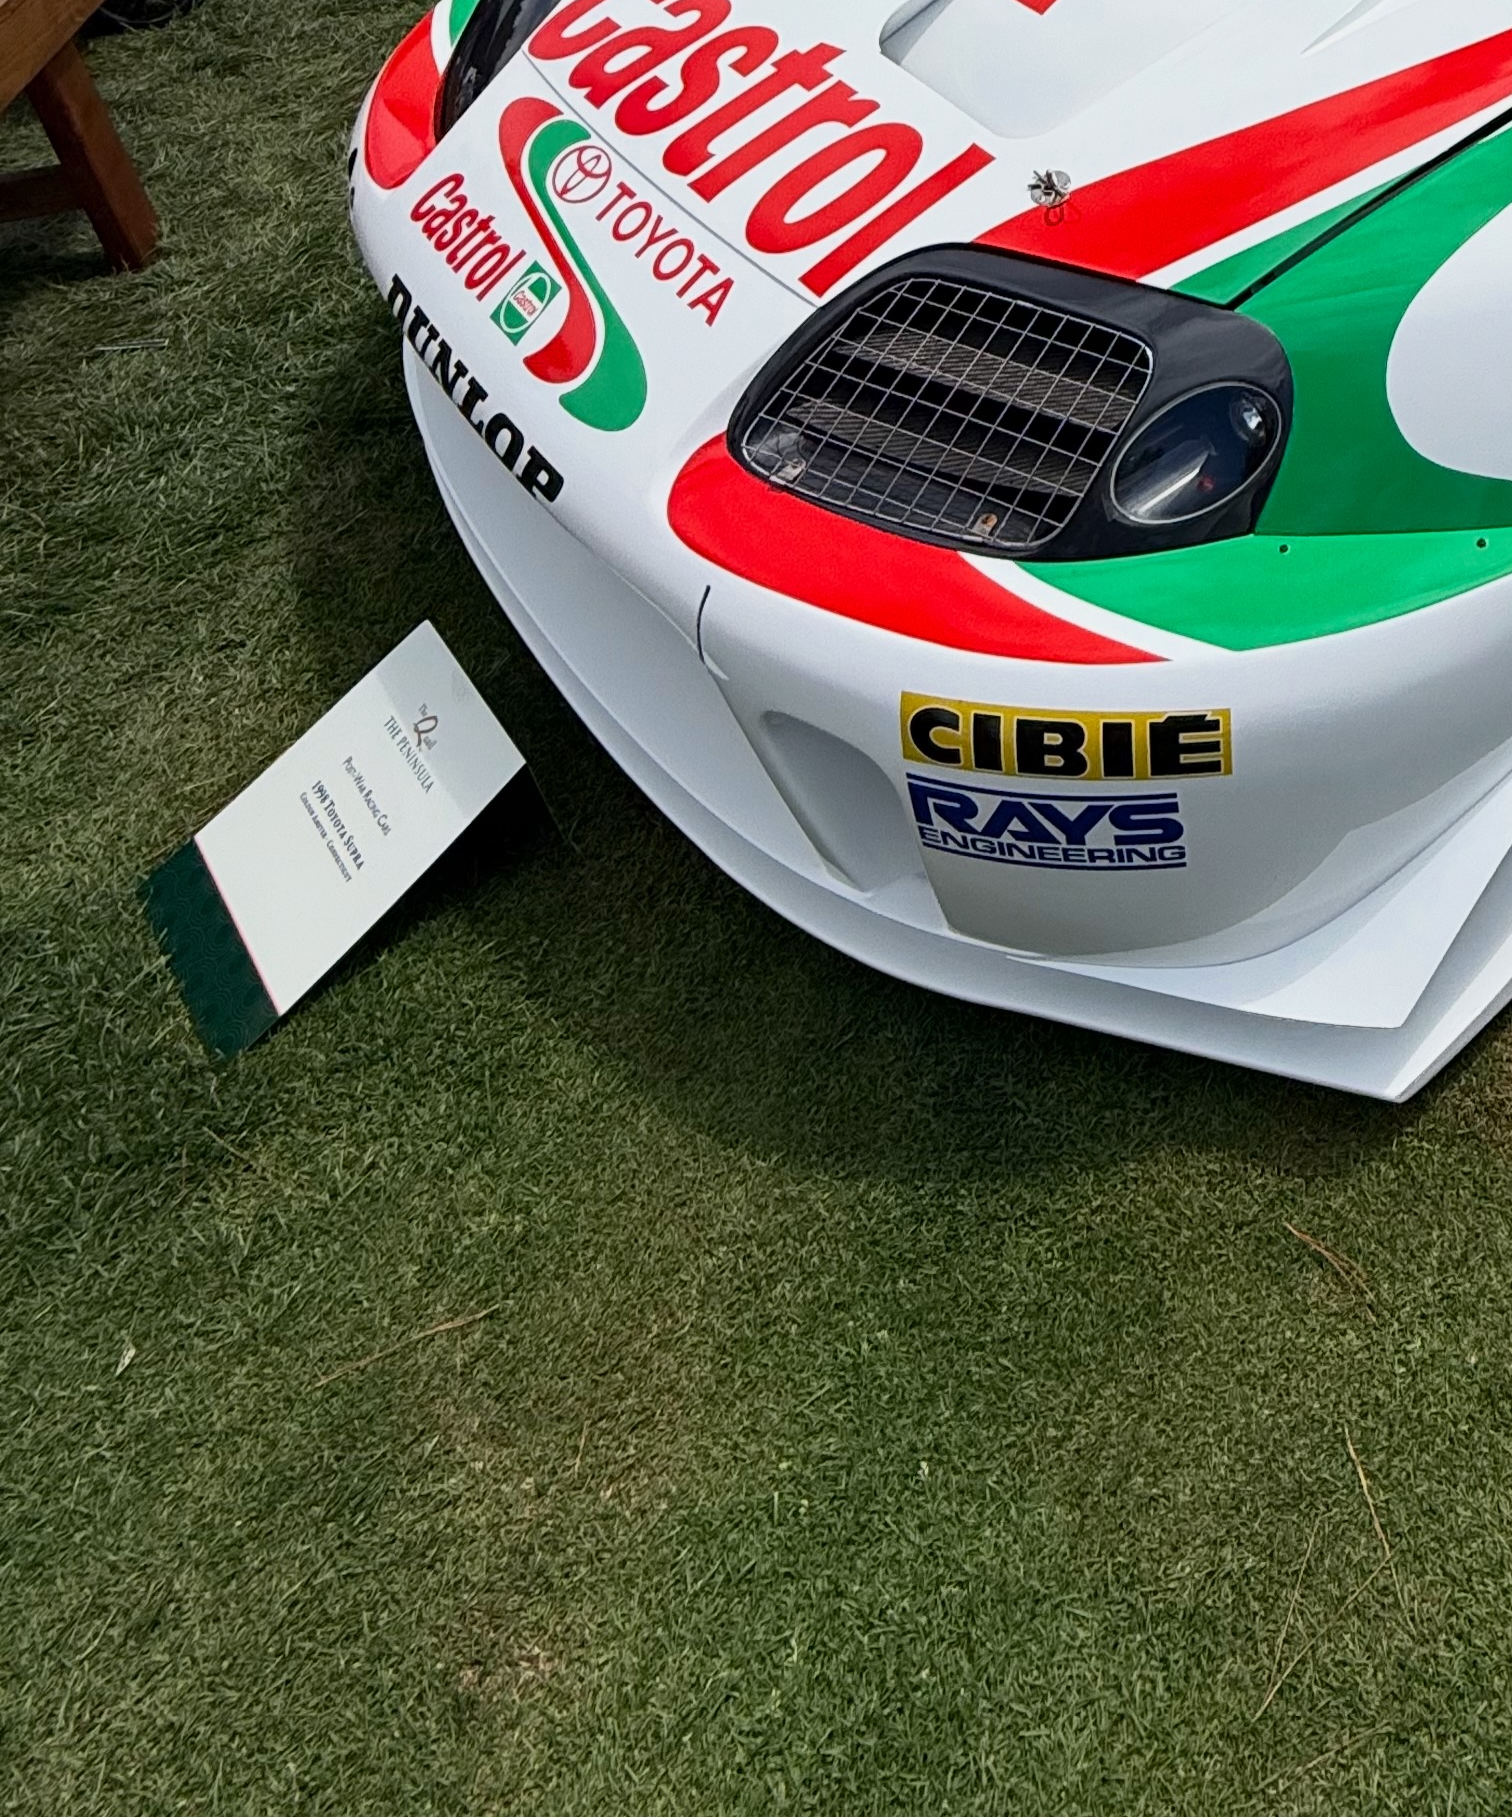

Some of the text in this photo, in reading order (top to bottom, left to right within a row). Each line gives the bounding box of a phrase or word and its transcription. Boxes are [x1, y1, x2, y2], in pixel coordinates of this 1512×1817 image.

[410, 173, 527, 303] Castrol
[595, 182, 737, 328] TOYOTA
[513, 290, 539, 318] Castrol
[387, 273, 565, 504] DUNLOP
[383, 715, 434, 795] THE PENINSULA
[906, 780, 1184, 847] RAYS
[917, 824, 1187, 864] ENGINEERING
